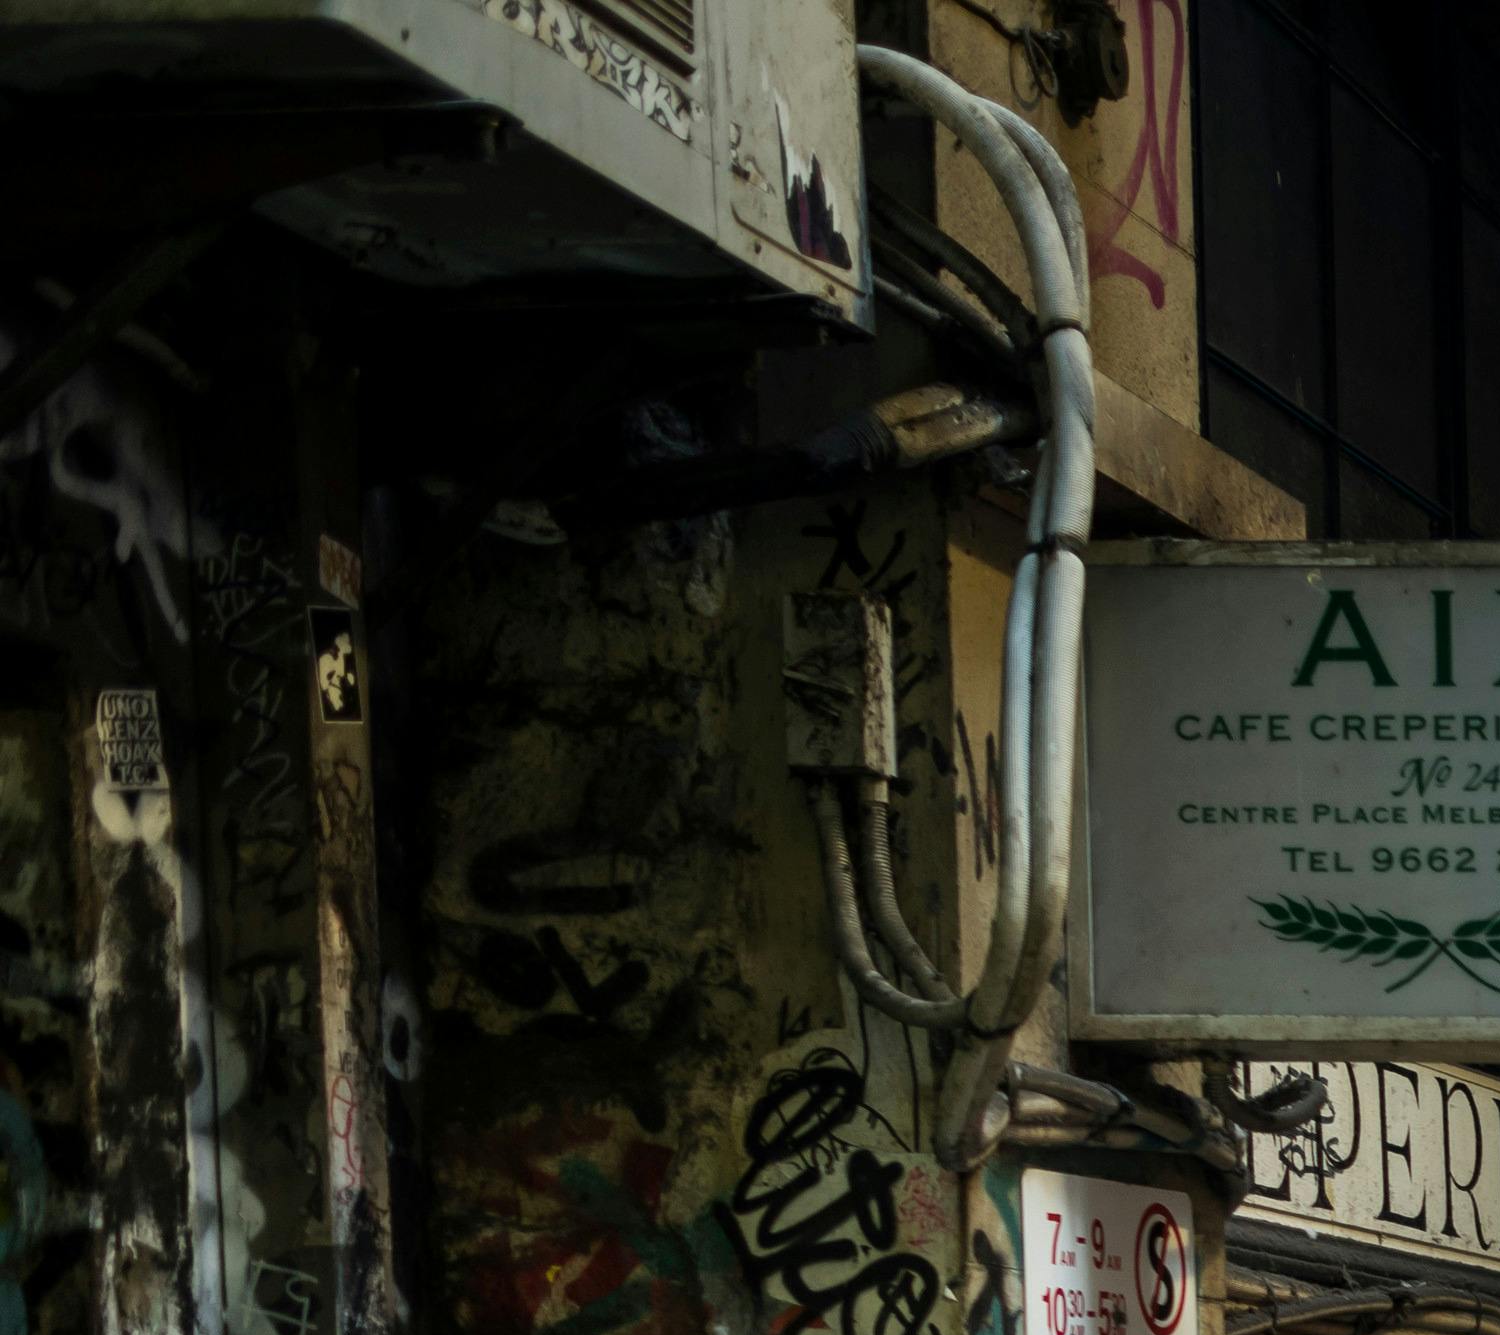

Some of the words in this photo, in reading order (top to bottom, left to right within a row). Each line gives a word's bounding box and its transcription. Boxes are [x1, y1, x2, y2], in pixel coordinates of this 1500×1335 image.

[1174, 714, 1292, 744] CAFE
[1372, 846, 1478, 874] 9662
[1046, 1212, 1062, 1265] 7
[1091, 1218, 1106, 1270] 9
